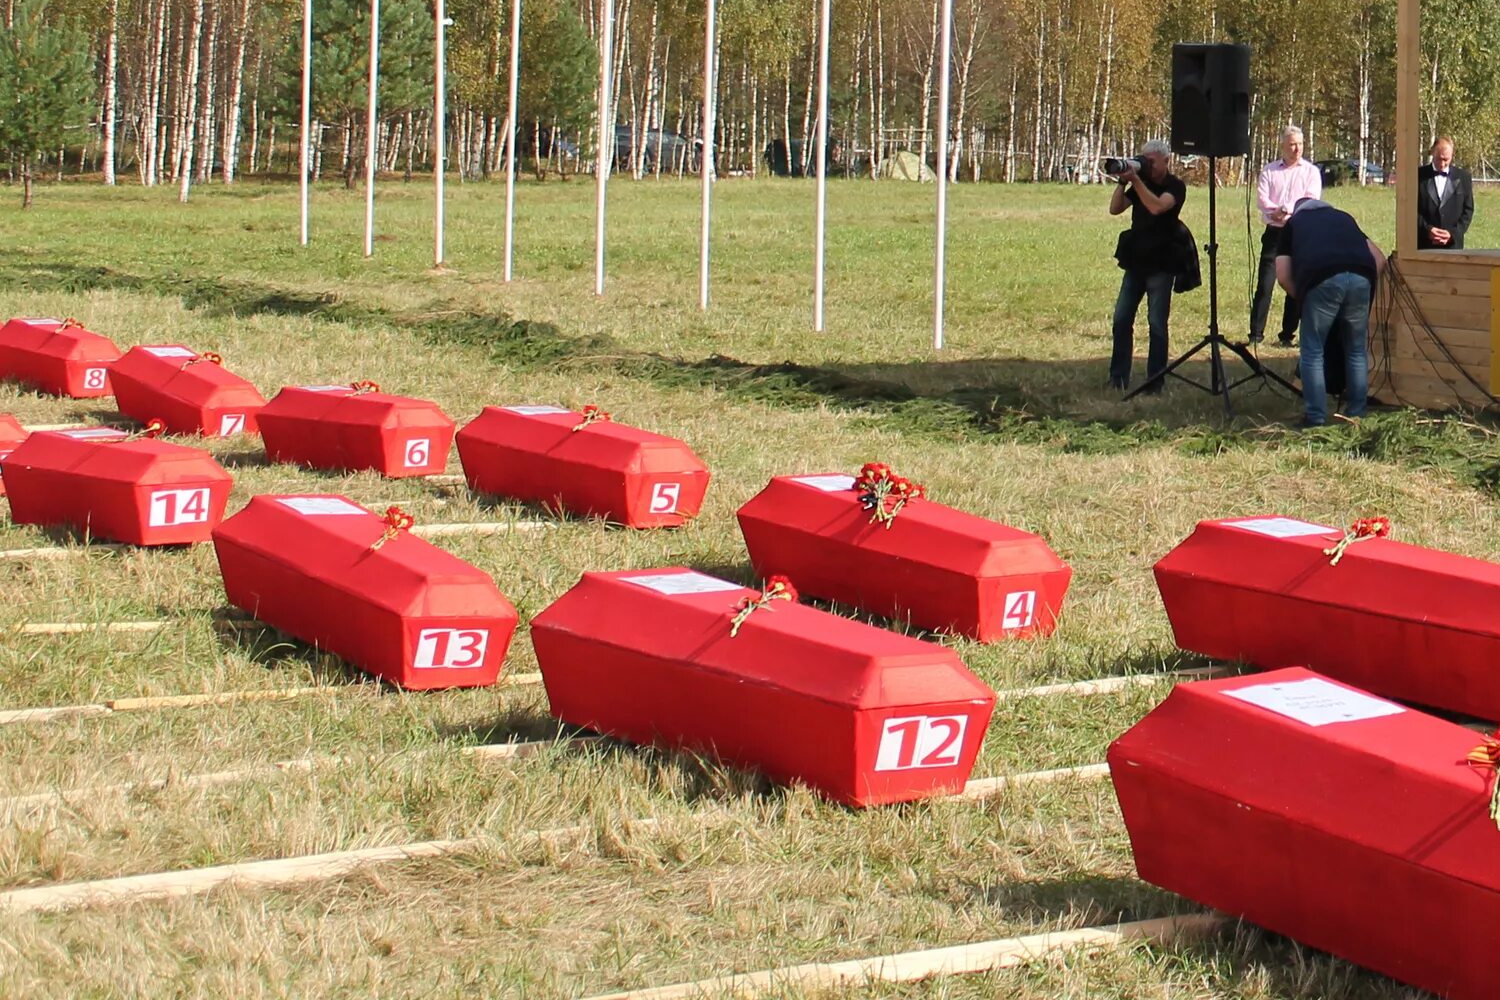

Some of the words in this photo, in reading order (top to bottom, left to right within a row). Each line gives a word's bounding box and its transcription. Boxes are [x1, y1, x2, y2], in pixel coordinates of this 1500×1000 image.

[87, 369, 103, 388] 8
[225, 415, 242, 435] 7
[407, 441, 426, 465] 6
[154, 490, 206, 524] 14
[652, 485, 676, 511] 5
[1005, 593, 1030, 626] 4
[423, 631, 483, 667] 13
[886, 719, 961, 768] 12
